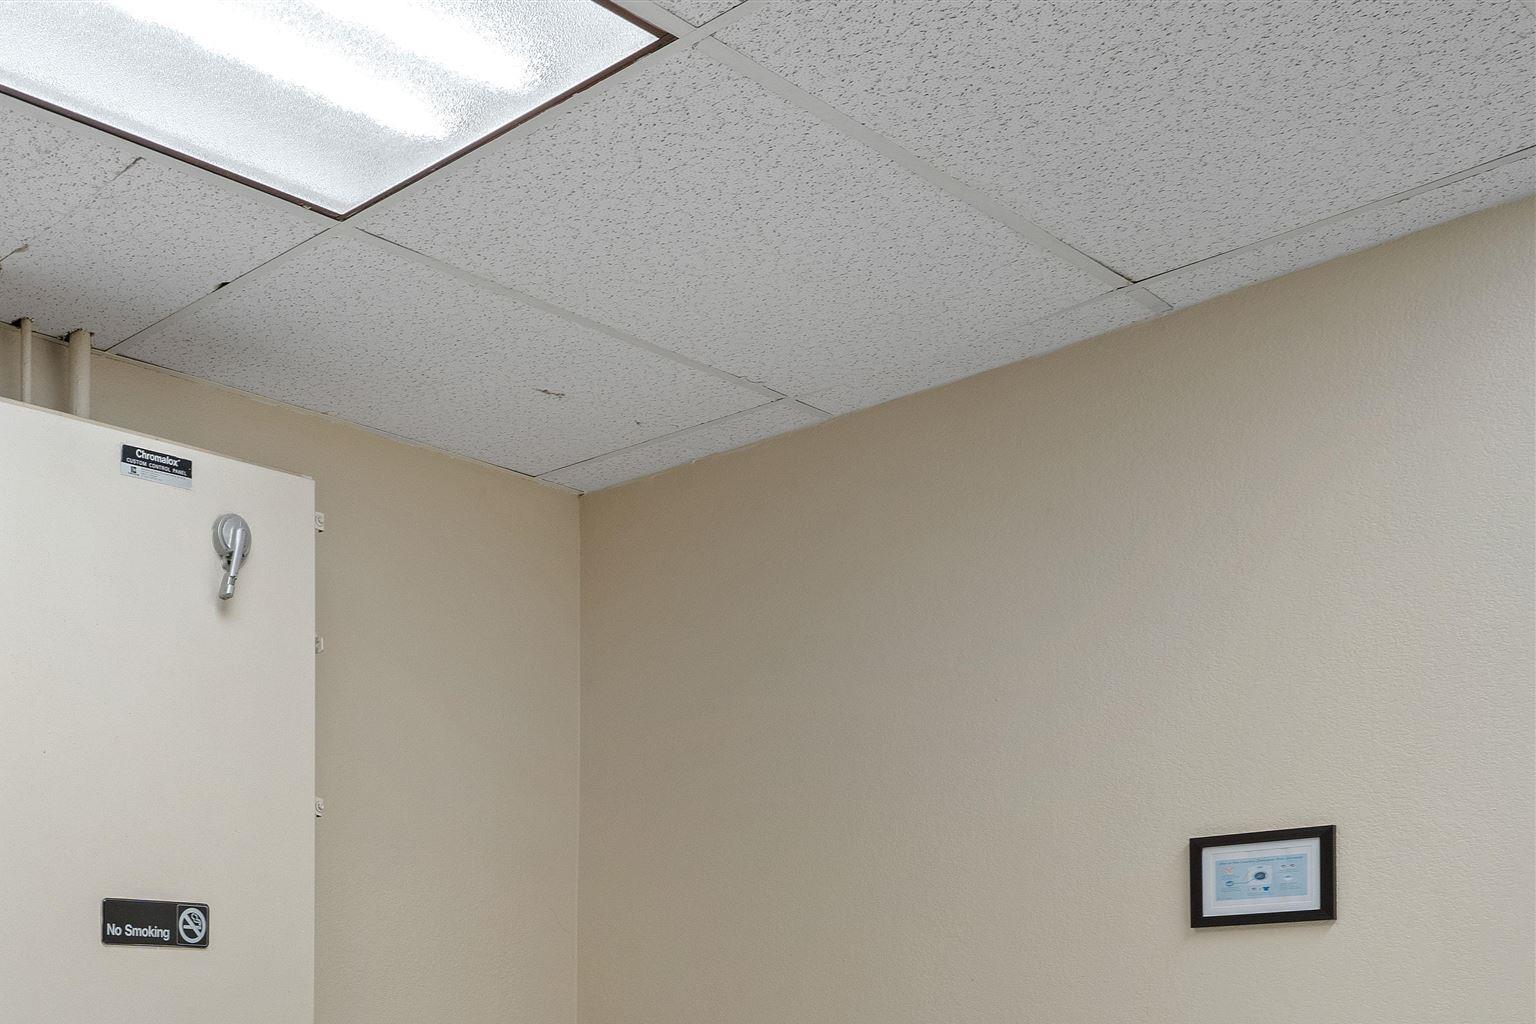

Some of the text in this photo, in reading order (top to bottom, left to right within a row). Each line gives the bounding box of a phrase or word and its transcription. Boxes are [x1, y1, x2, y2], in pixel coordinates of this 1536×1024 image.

[126, 457, 148, 467] CUSTOM
[148, 462, 171, 473] CONTROL
[135, 448, 179, 467] Chromalox
[106, 922, 171, 941] No Smoking
